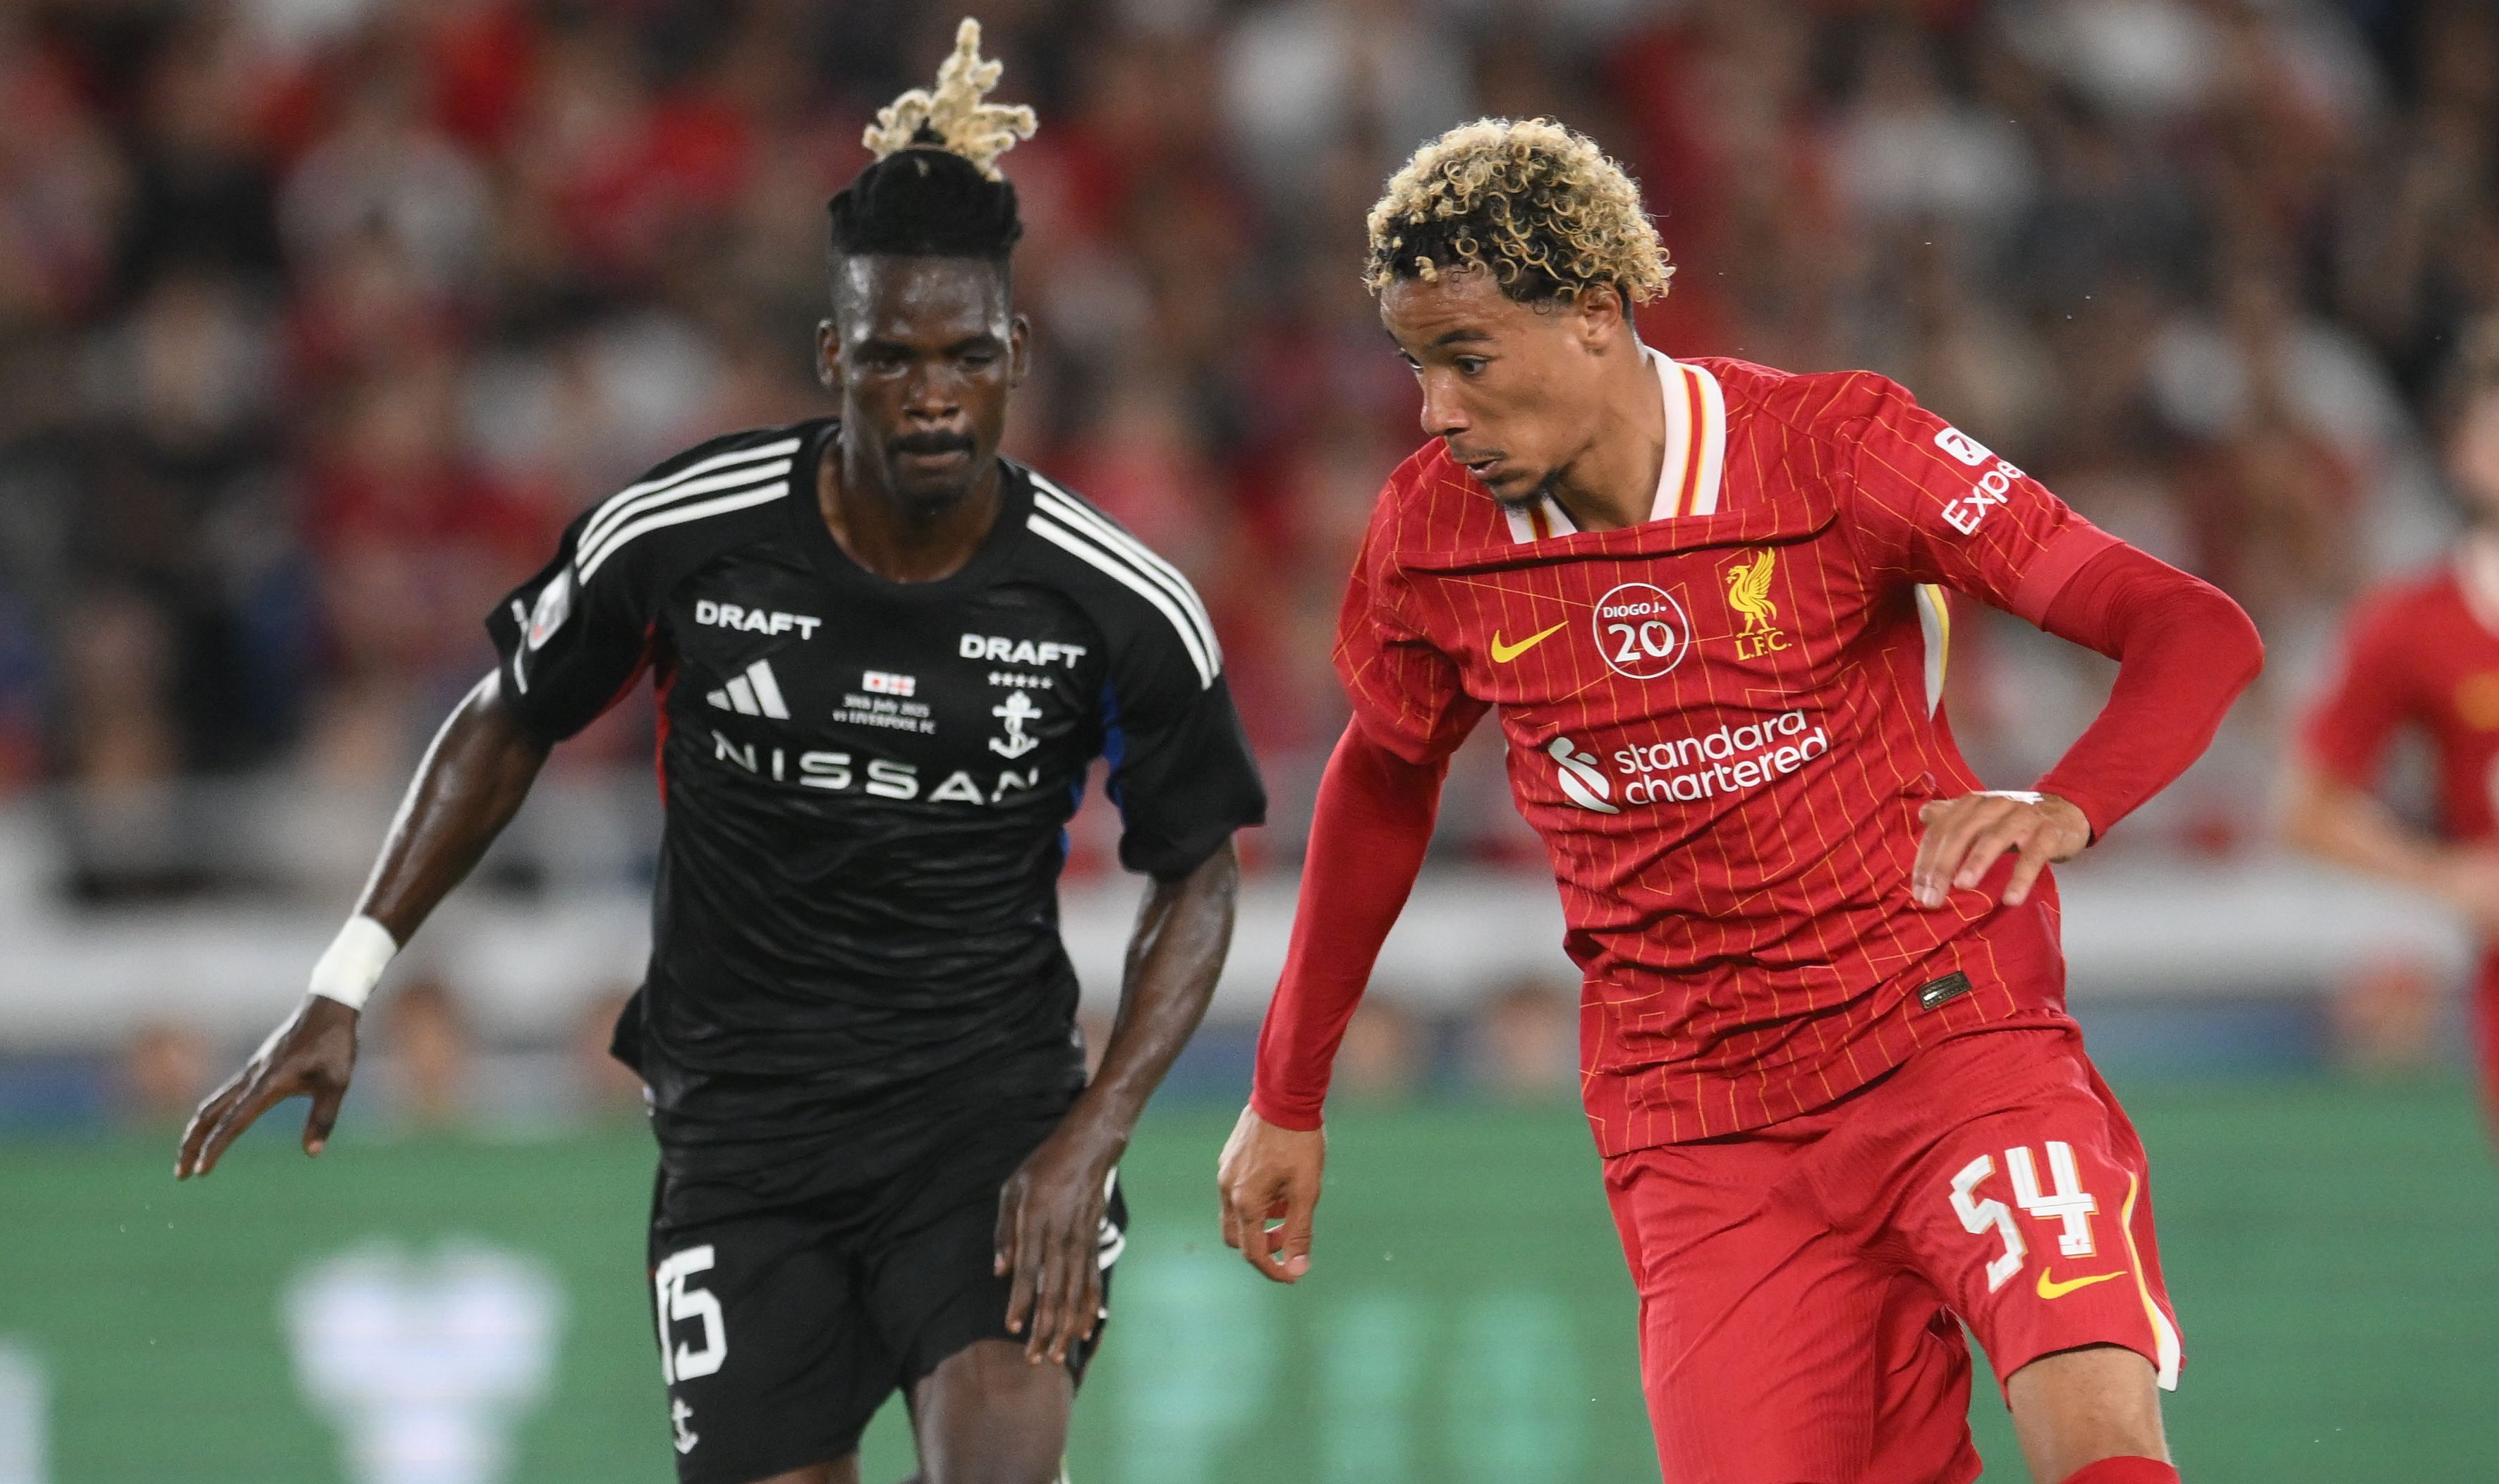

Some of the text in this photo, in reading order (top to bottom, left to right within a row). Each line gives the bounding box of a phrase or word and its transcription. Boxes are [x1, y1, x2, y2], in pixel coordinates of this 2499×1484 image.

[1941, 461, 2026, 535] Expe
[695, 600, 821, 640] DRAFT
[1603, 602, 1650, 619] DIOGO
[959, 633, 1086, 669] DRAFT
[1608, 620, 1675, 663] 20
[1734, 631, 1792, 661] L.F.C.
[849, 710, 918, 732] LIVERPOOL
[1614, 707, 1807, 774] standard
[712, 729, 1040, 805] NISSAN
[1625, 727, 1828, 805] chartered
[1949, 1141, 2100, 1294] 54
[655, 1244, 728, 1385] 15
